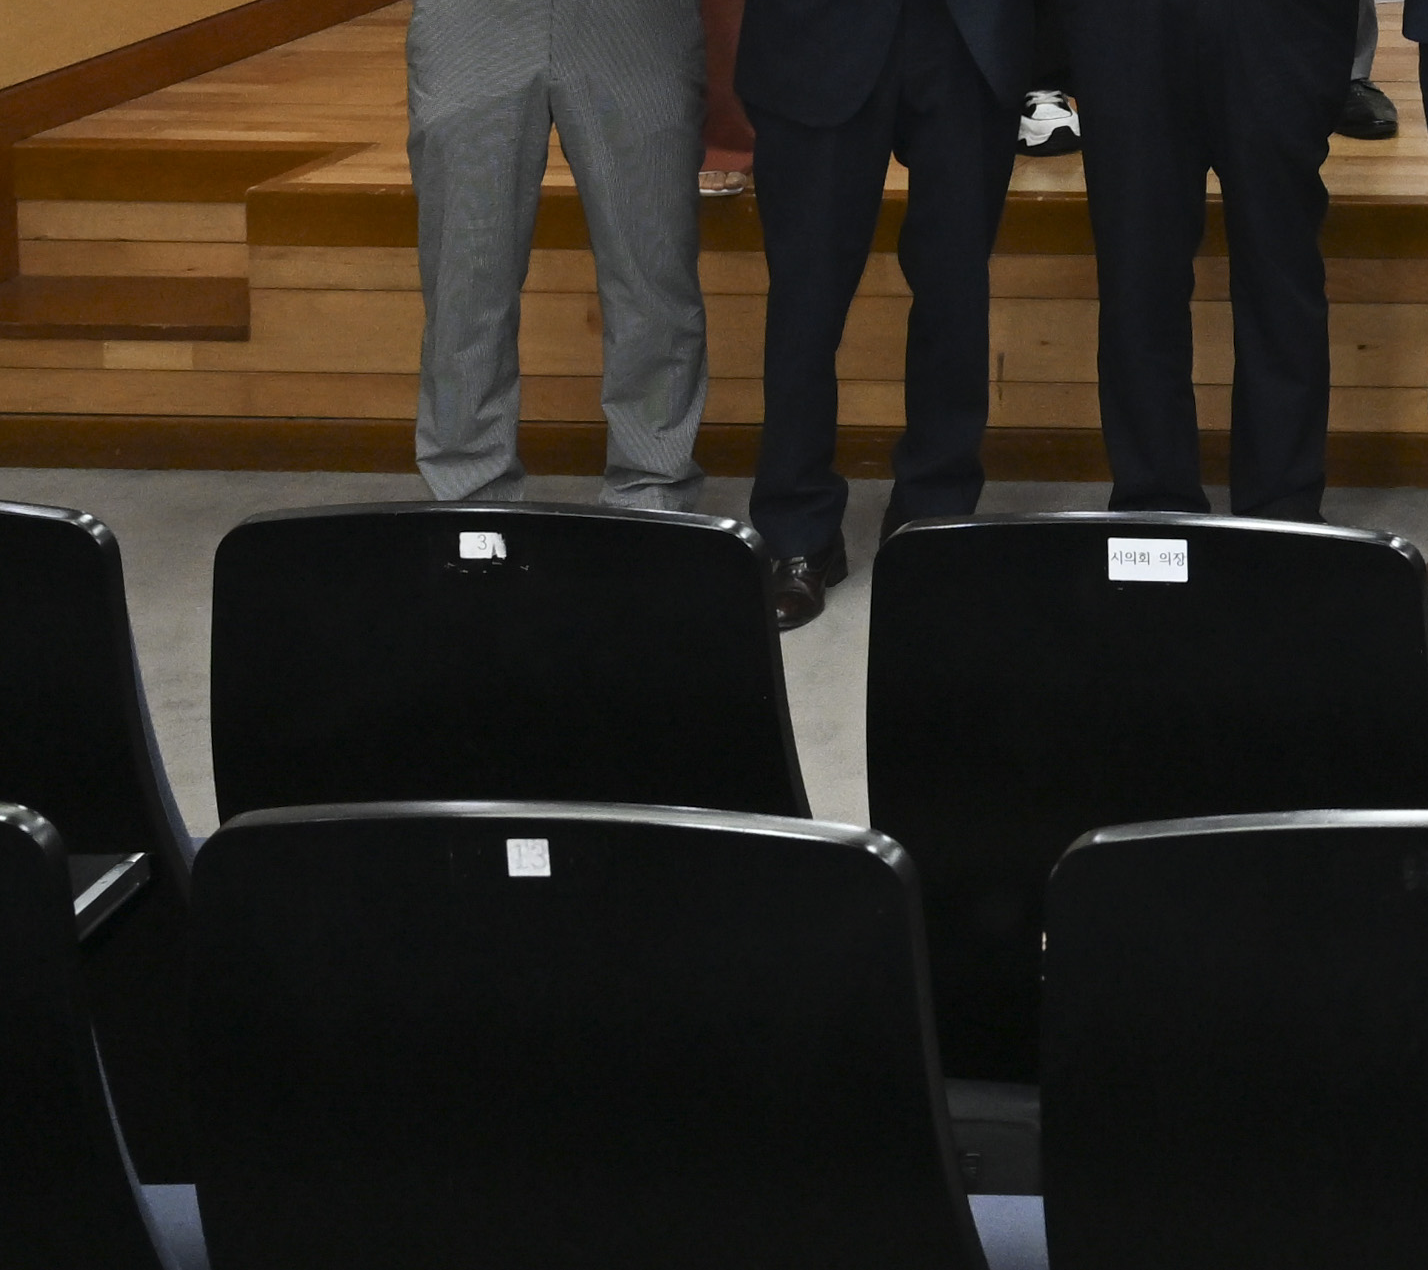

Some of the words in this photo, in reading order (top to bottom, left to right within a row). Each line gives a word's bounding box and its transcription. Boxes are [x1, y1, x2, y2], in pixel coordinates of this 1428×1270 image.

[477, 534, 487, 550] 3
[1111, 551, 1150, 565] 시의회
[1159, 552, 1186, 566] 의장
